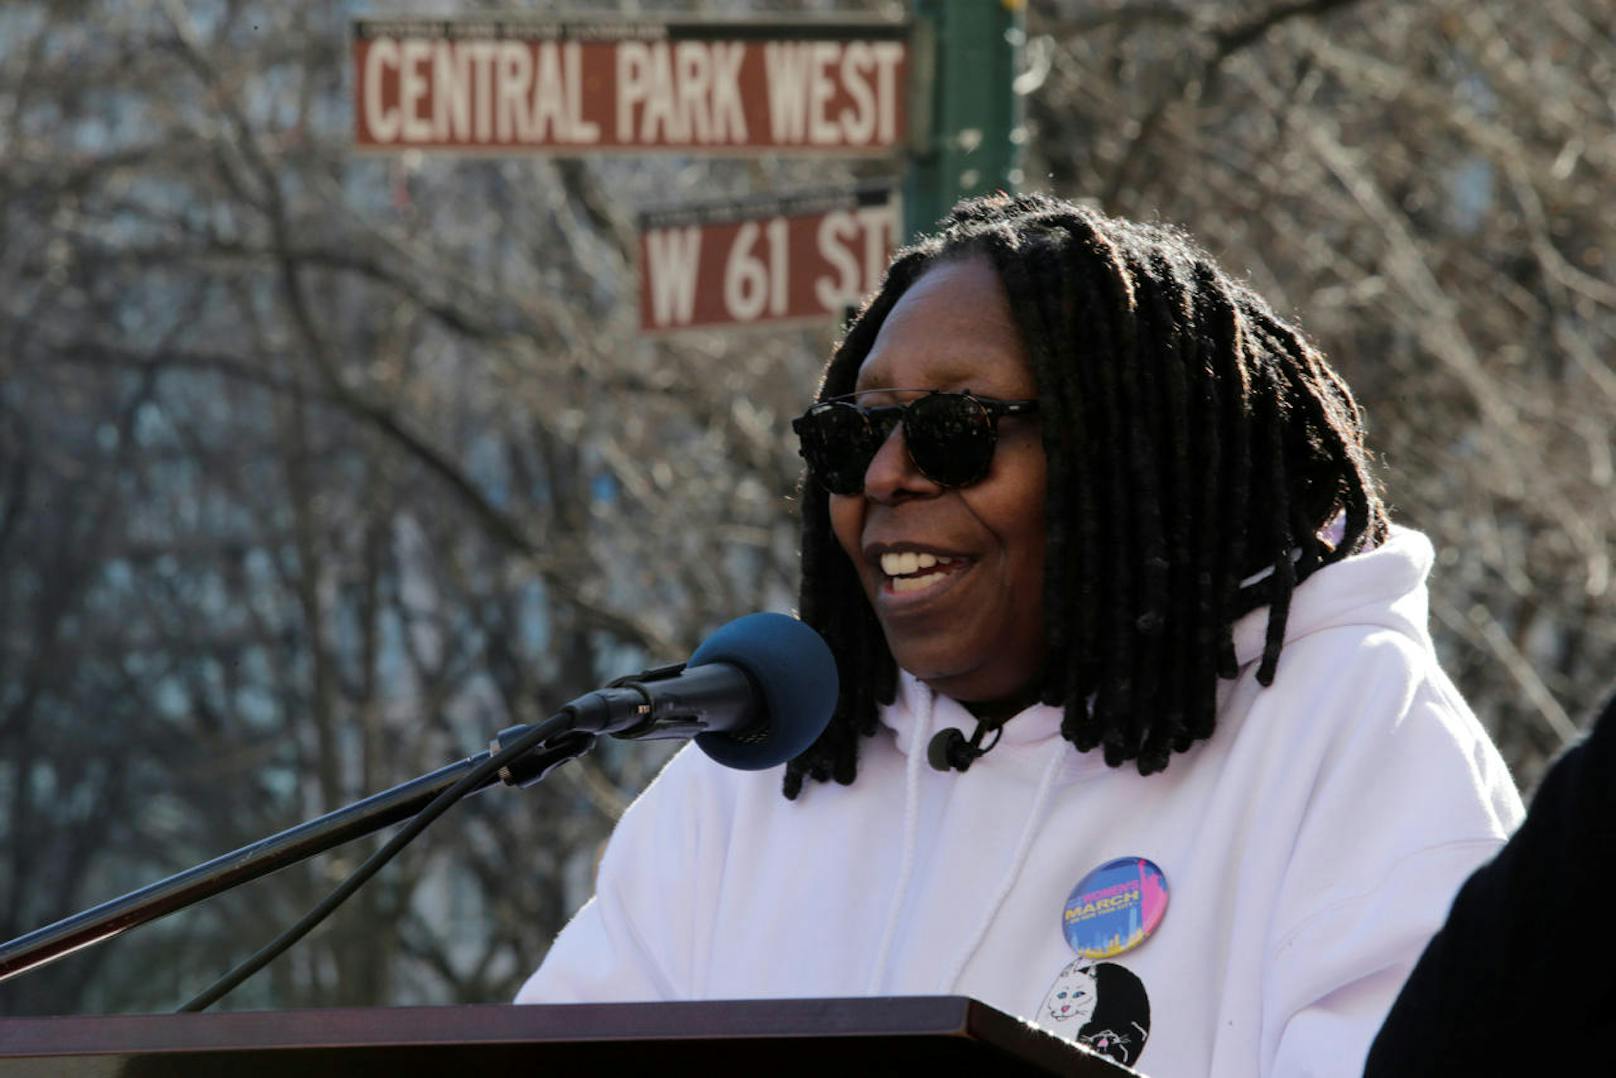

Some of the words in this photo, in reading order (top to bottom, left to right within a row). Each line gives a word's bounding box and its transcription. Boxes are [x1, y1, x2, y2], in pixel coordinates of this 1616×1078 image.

[365, 39, 598, 143] CENTRAL
[617, 42, 748, 143] PARK
[765, 42, 903, 143] WEST
[647, 228, 702, 325] W
[725, 218, 789, 320] 61
[815, 209, 890, 312] ST
[1065, 890, 1139, 920] MARCH
